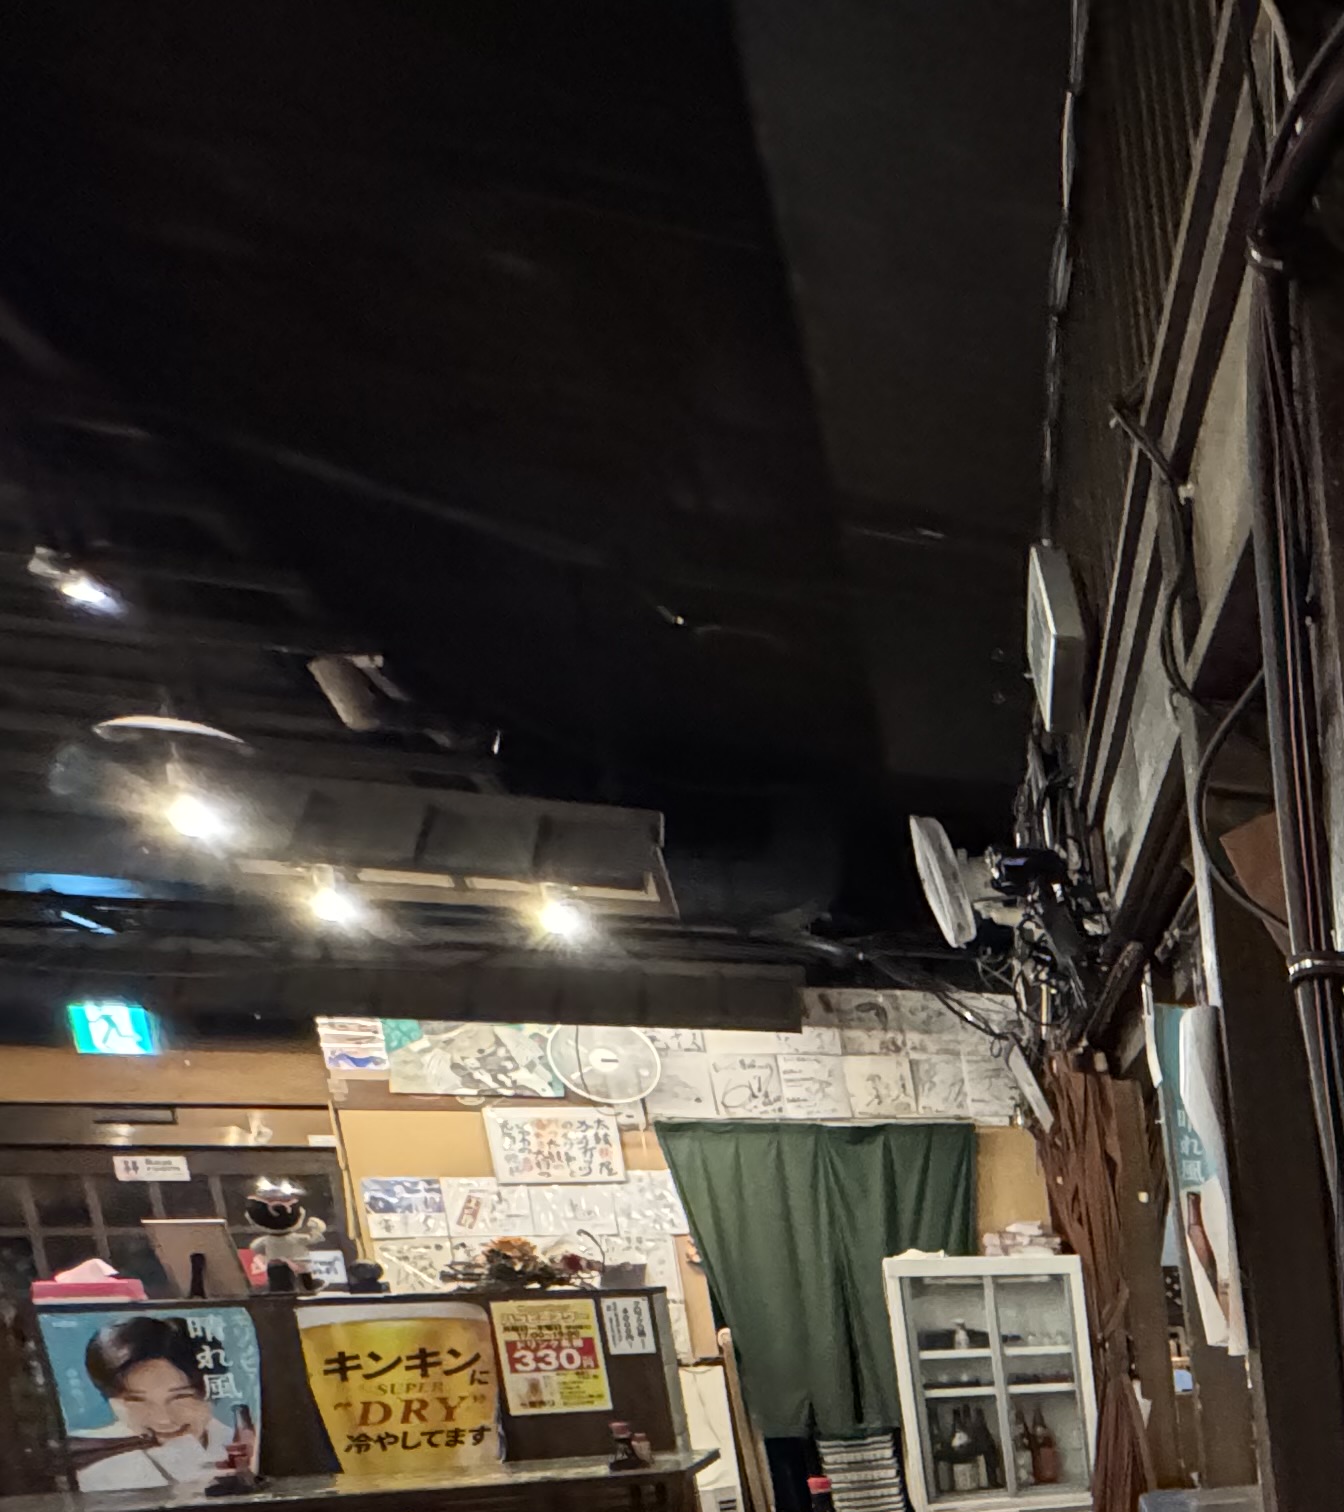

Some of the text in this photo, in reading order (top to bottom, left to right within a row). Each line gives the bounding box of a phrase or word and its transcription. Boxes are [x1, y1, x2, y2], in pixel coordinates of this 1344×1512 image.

[343, 1425, 492, 1455] 冷やしてます
